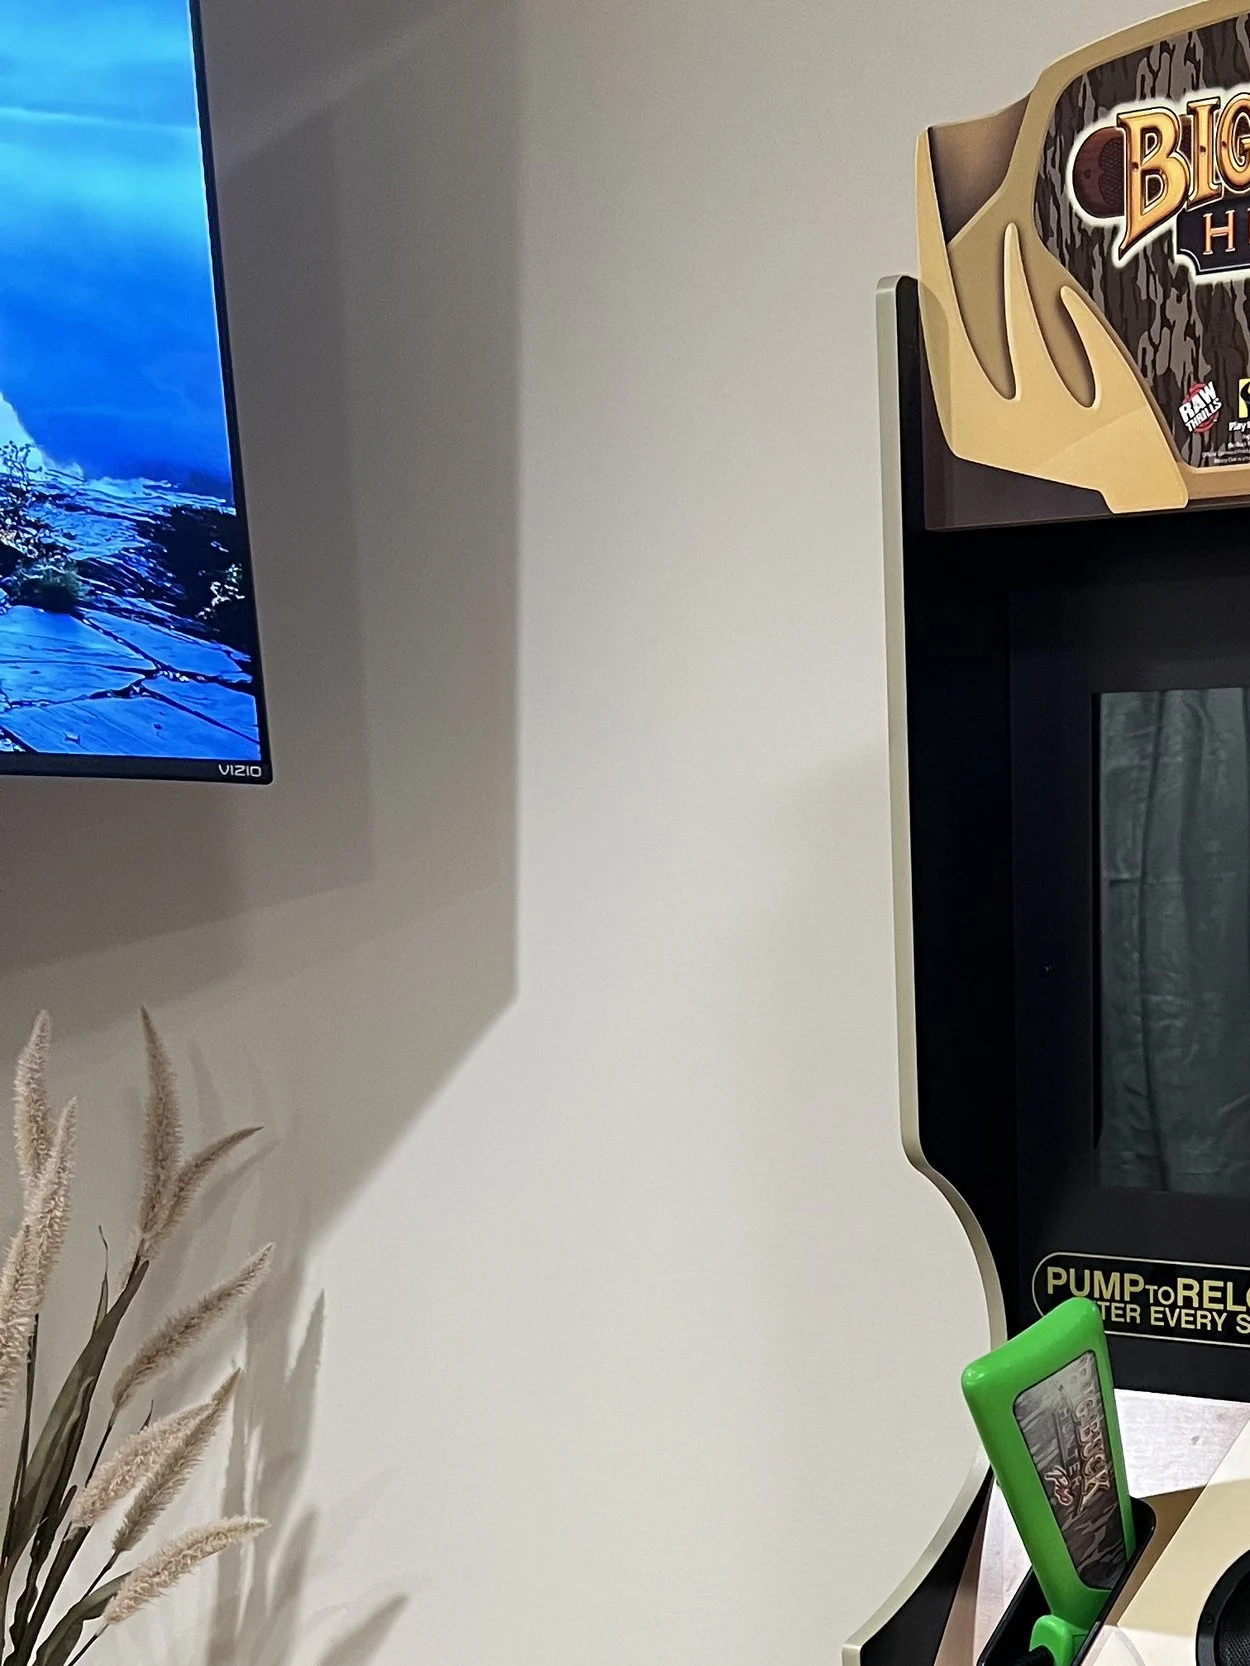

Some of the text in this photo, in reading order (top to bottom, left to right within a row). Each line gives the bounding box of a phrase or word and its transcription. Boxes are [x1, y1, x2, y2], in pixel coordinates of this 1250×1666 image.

[1179, 381, 1217, 421] RAW
[1185, 397, 1222, 432] THRILLS
[1229, 421, 1247, 432] Play
[218, 764, 262, 777] VIZIO
[1047, 1266, 1144, 1301] PUMP
[1097, 1301, 1141, 1324] TER
[1150, 1306, 1228, 1333] EVERY
[1058, 1408, 1083, 1489] HUNTER
[1077, 1413, 1111, 1511] BUCK
[1045, 1465, 1073, 1505] Pro
